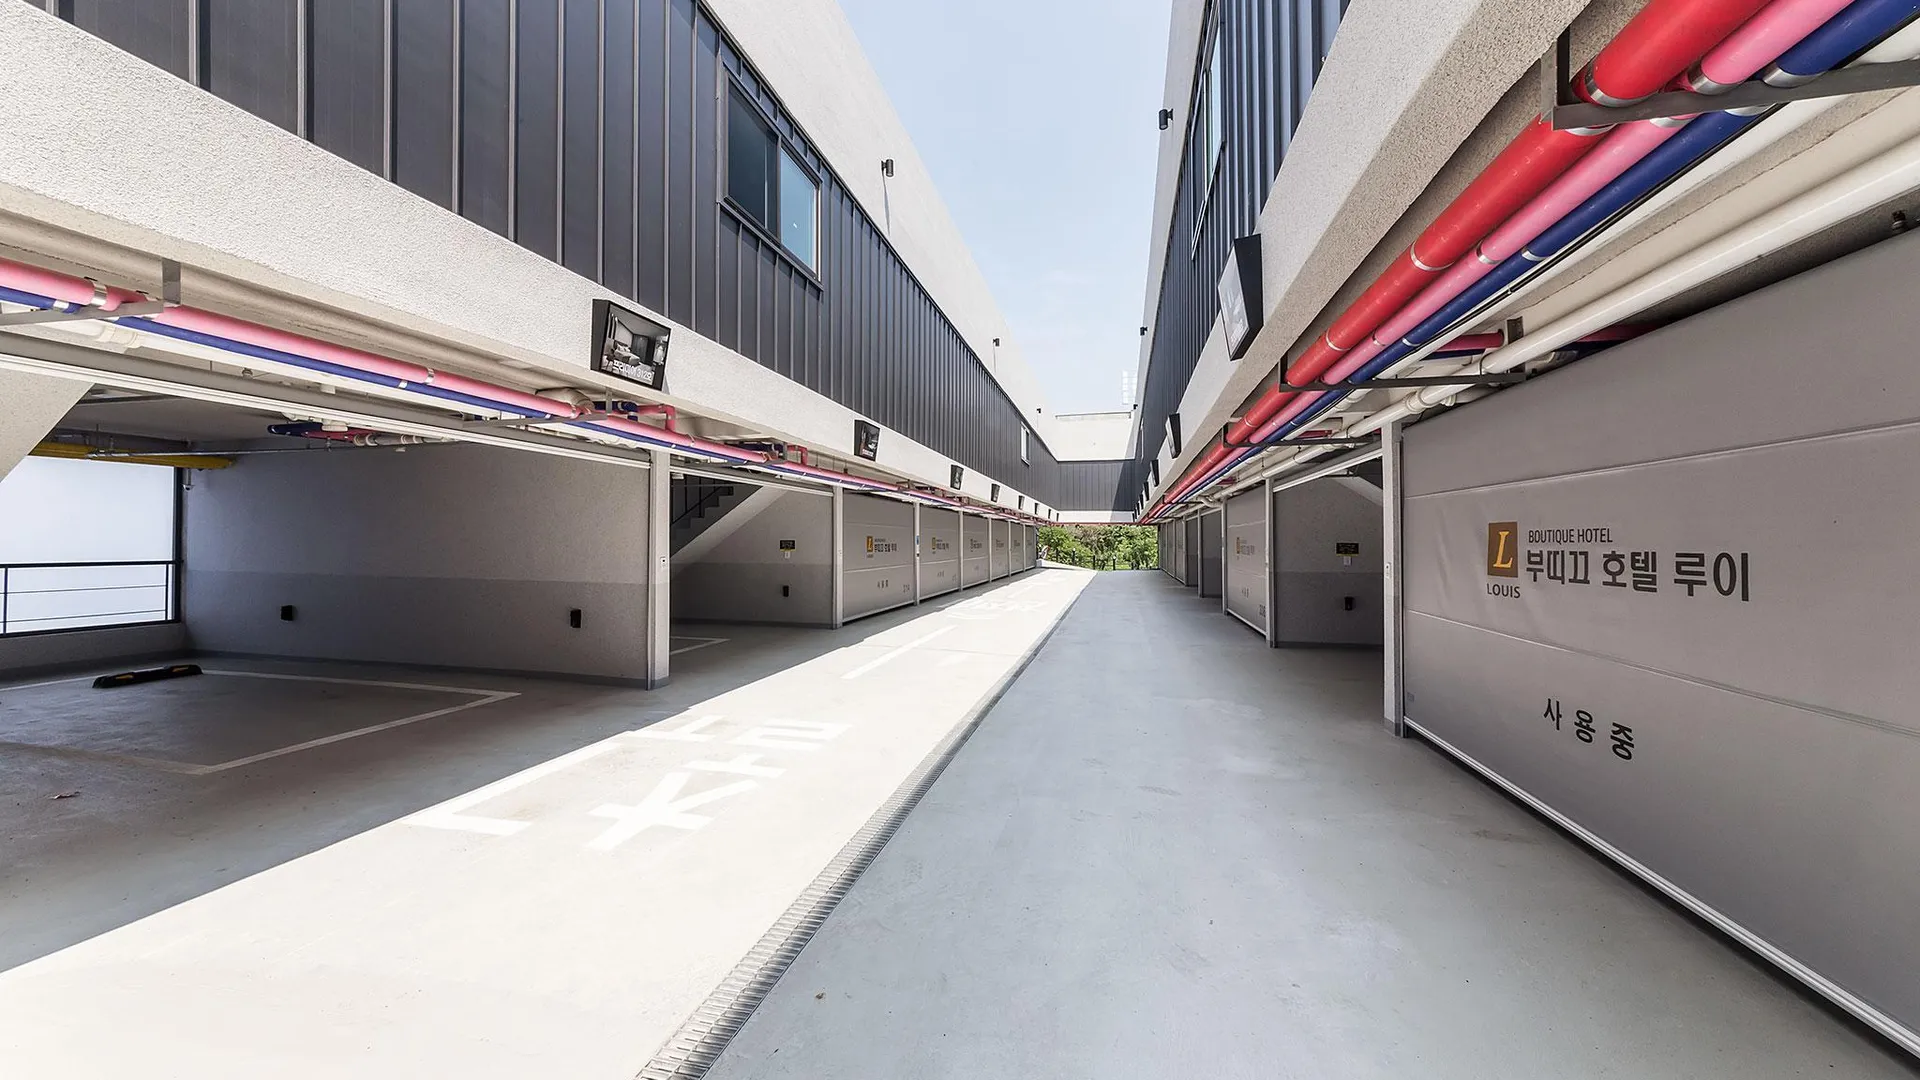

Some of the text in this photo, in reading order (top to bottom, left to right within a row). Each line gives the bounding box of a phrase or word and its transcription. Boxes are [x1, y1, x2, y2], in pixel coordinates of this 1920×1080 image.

[1493, 530, 1514, 569] L
[1528, 528, 1613, 546] BOUTIQUE HOTEL
[1526, 550, 1749, 602] 부띠끄 호텔 루이
[1486, 583, 1521, 599] LOUIS
